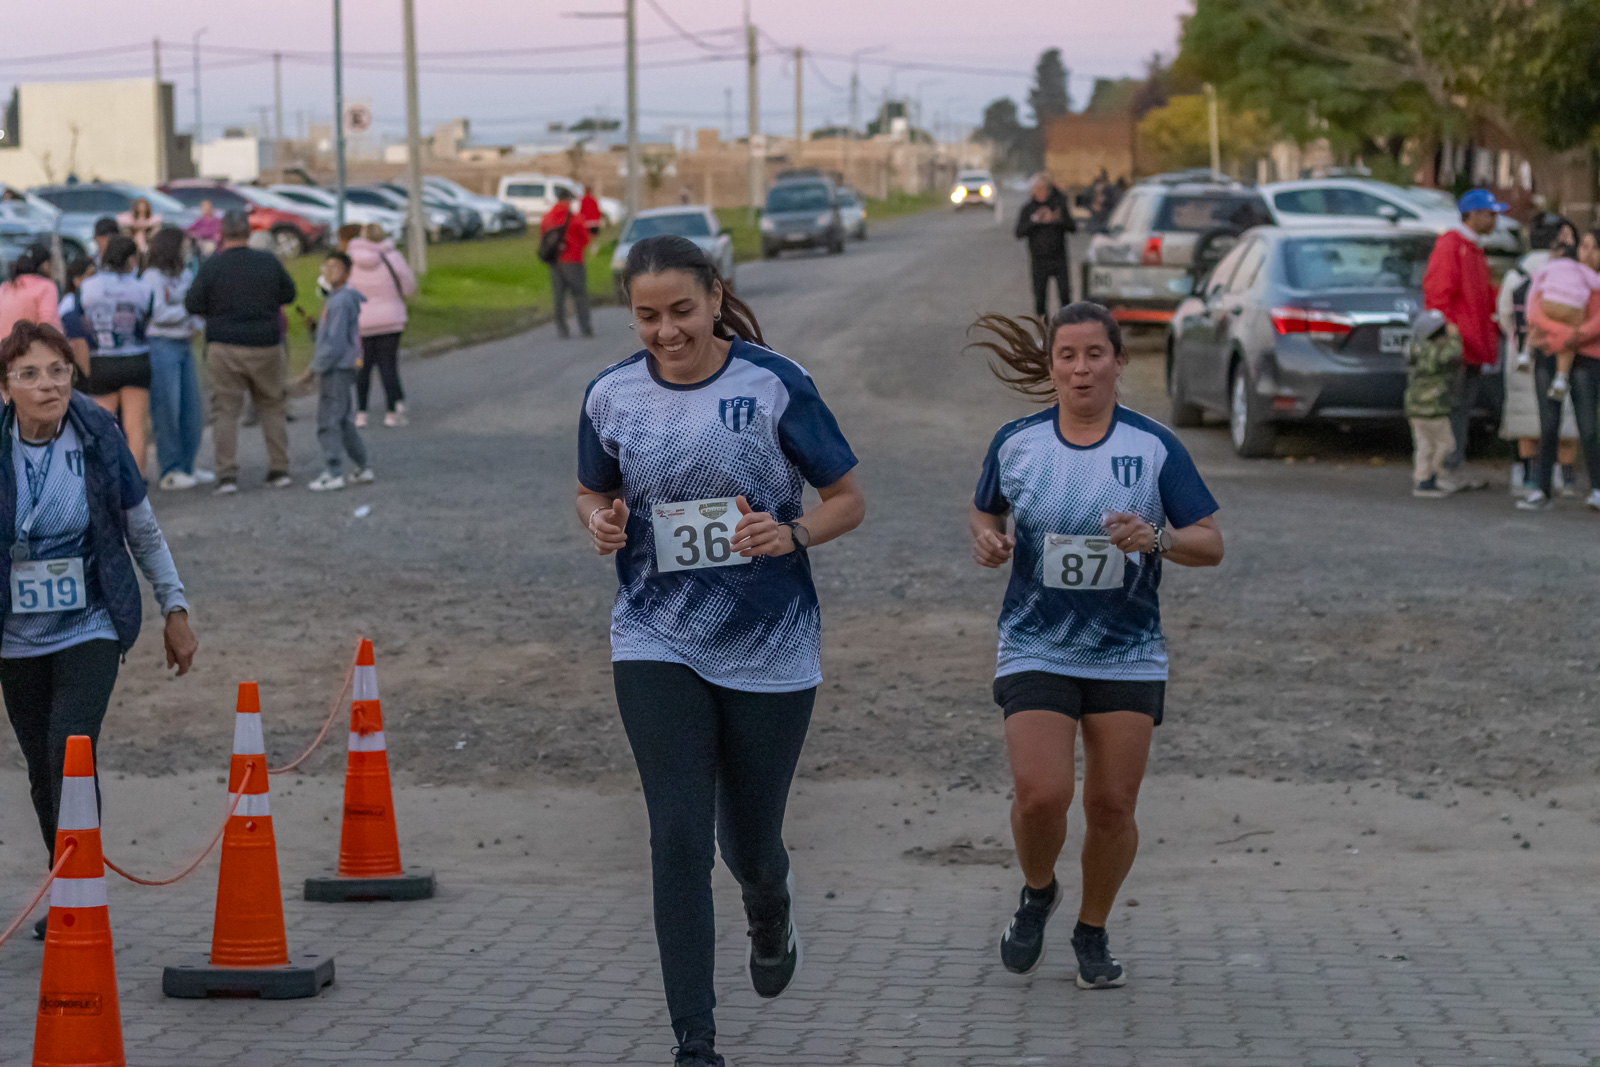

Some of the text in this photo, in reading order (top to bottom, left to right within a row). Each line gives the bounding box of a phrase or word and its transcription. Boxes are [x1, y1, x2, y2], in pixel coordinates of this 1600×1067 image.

[725, 398, 750, 408] SFC
[1117, 458, 1138, 466] SFC
[673, 521, 731, 567] 36
[1061, 553, 1108, 587] 87
[17, 576, 78, 610] 519
